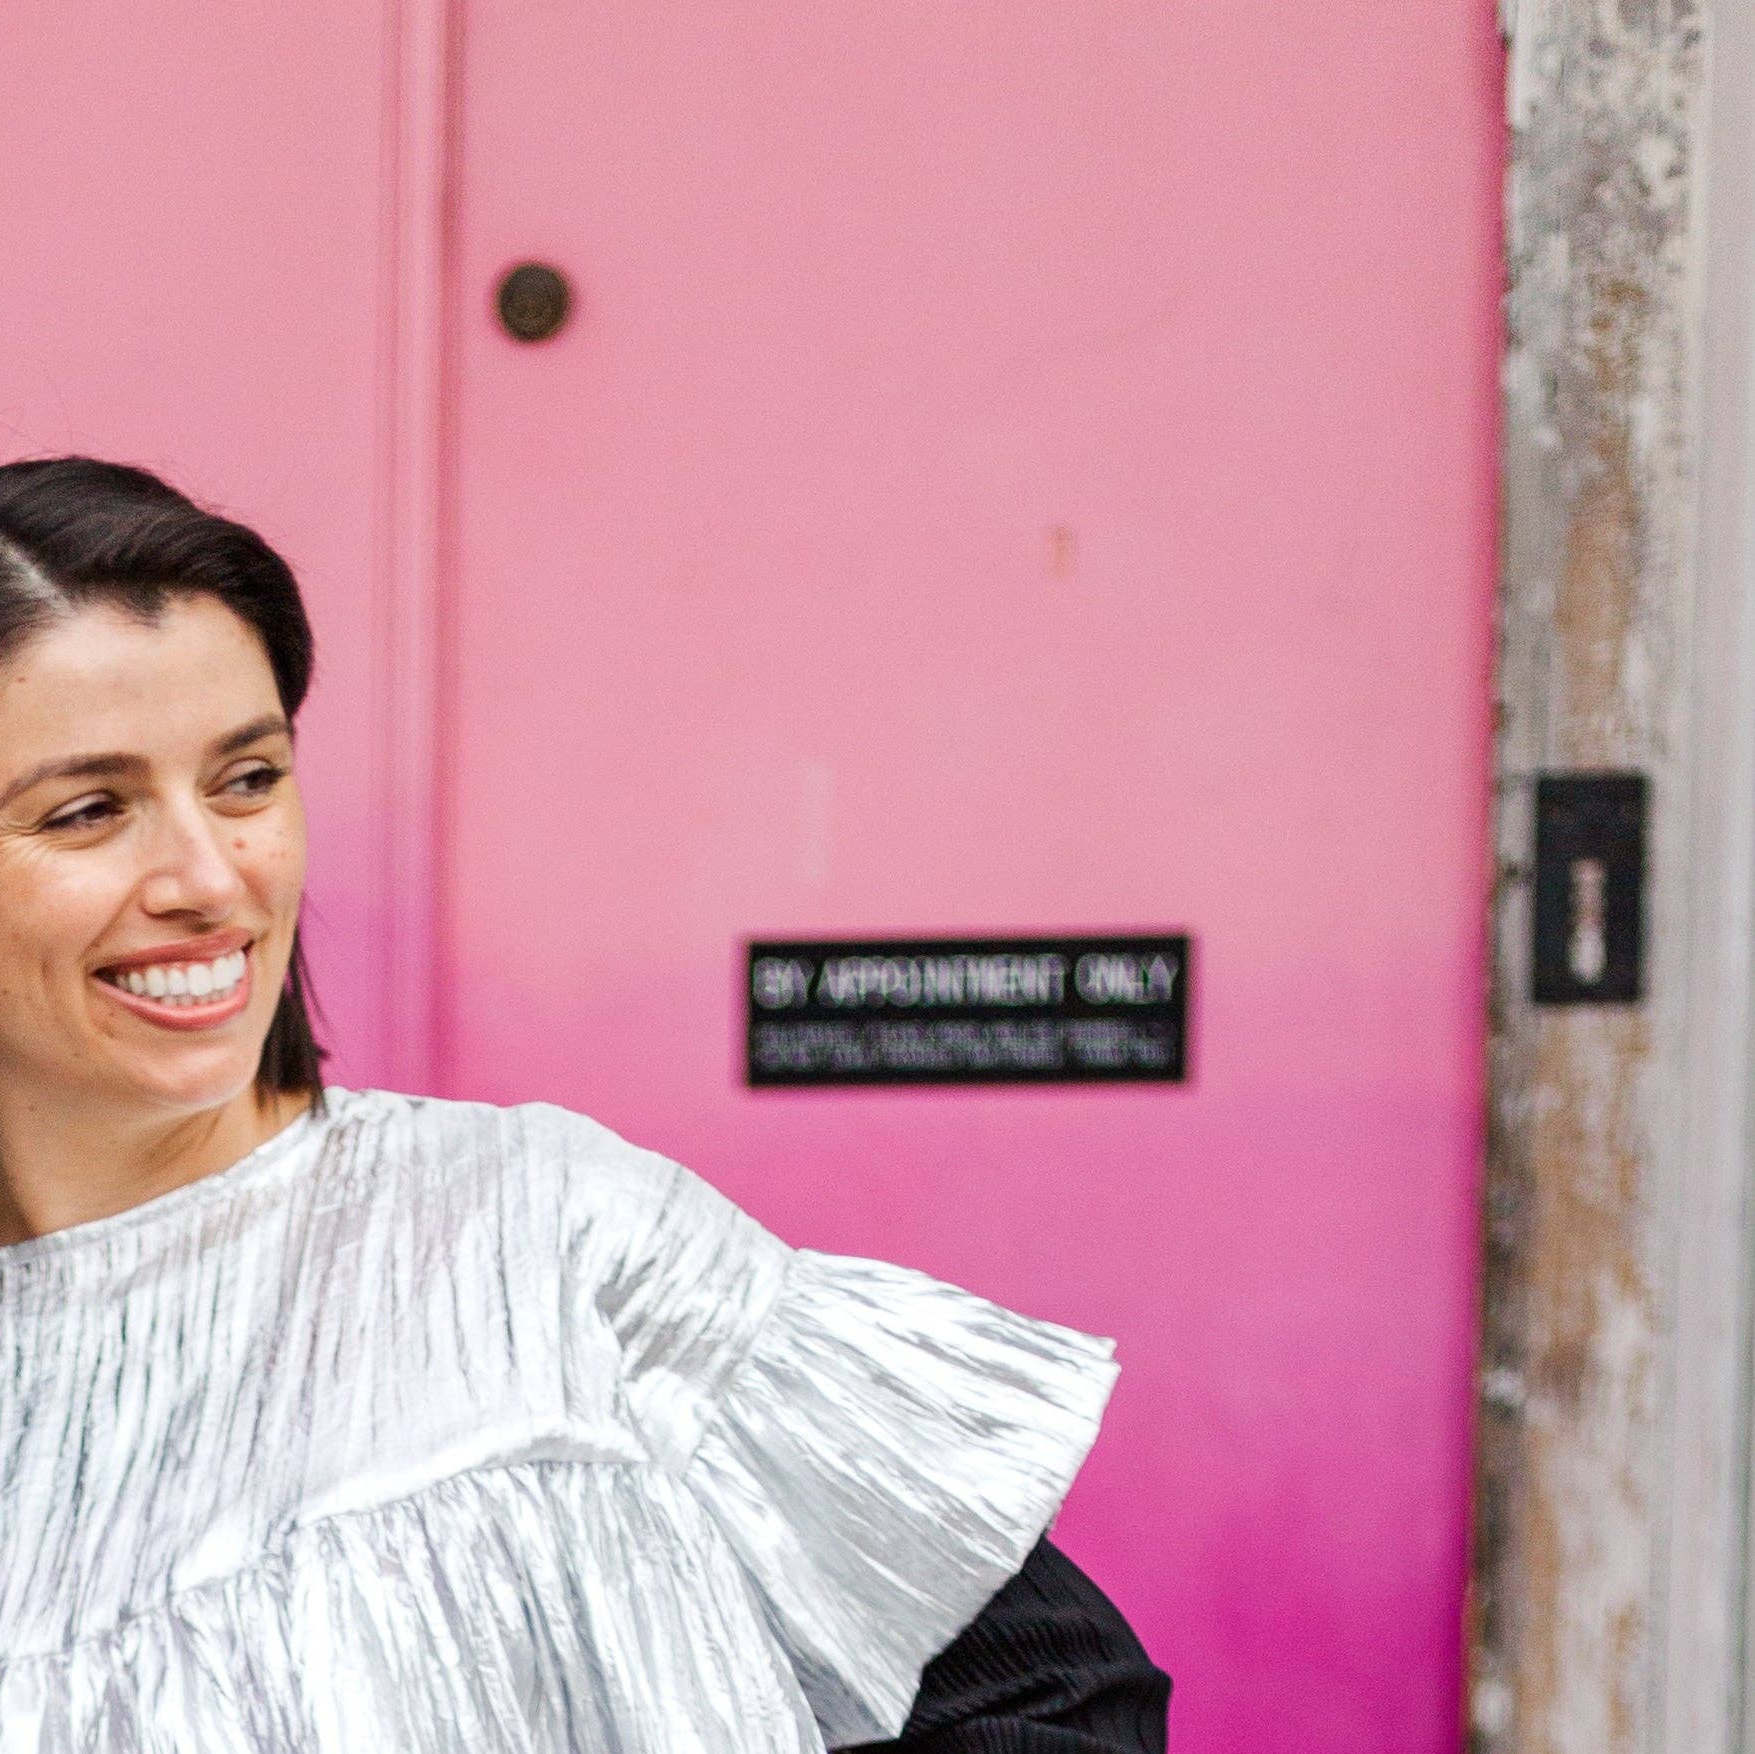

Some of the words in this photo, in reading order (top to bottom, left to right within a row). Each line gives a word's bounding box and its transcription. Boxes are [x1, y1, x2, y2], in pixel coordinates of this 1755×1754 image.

[753, 955, 816, 1010] BY
[817, 953, 1068, 1009] APPOINTMENT
[1075, 952, 1179, 1006] ONLY
